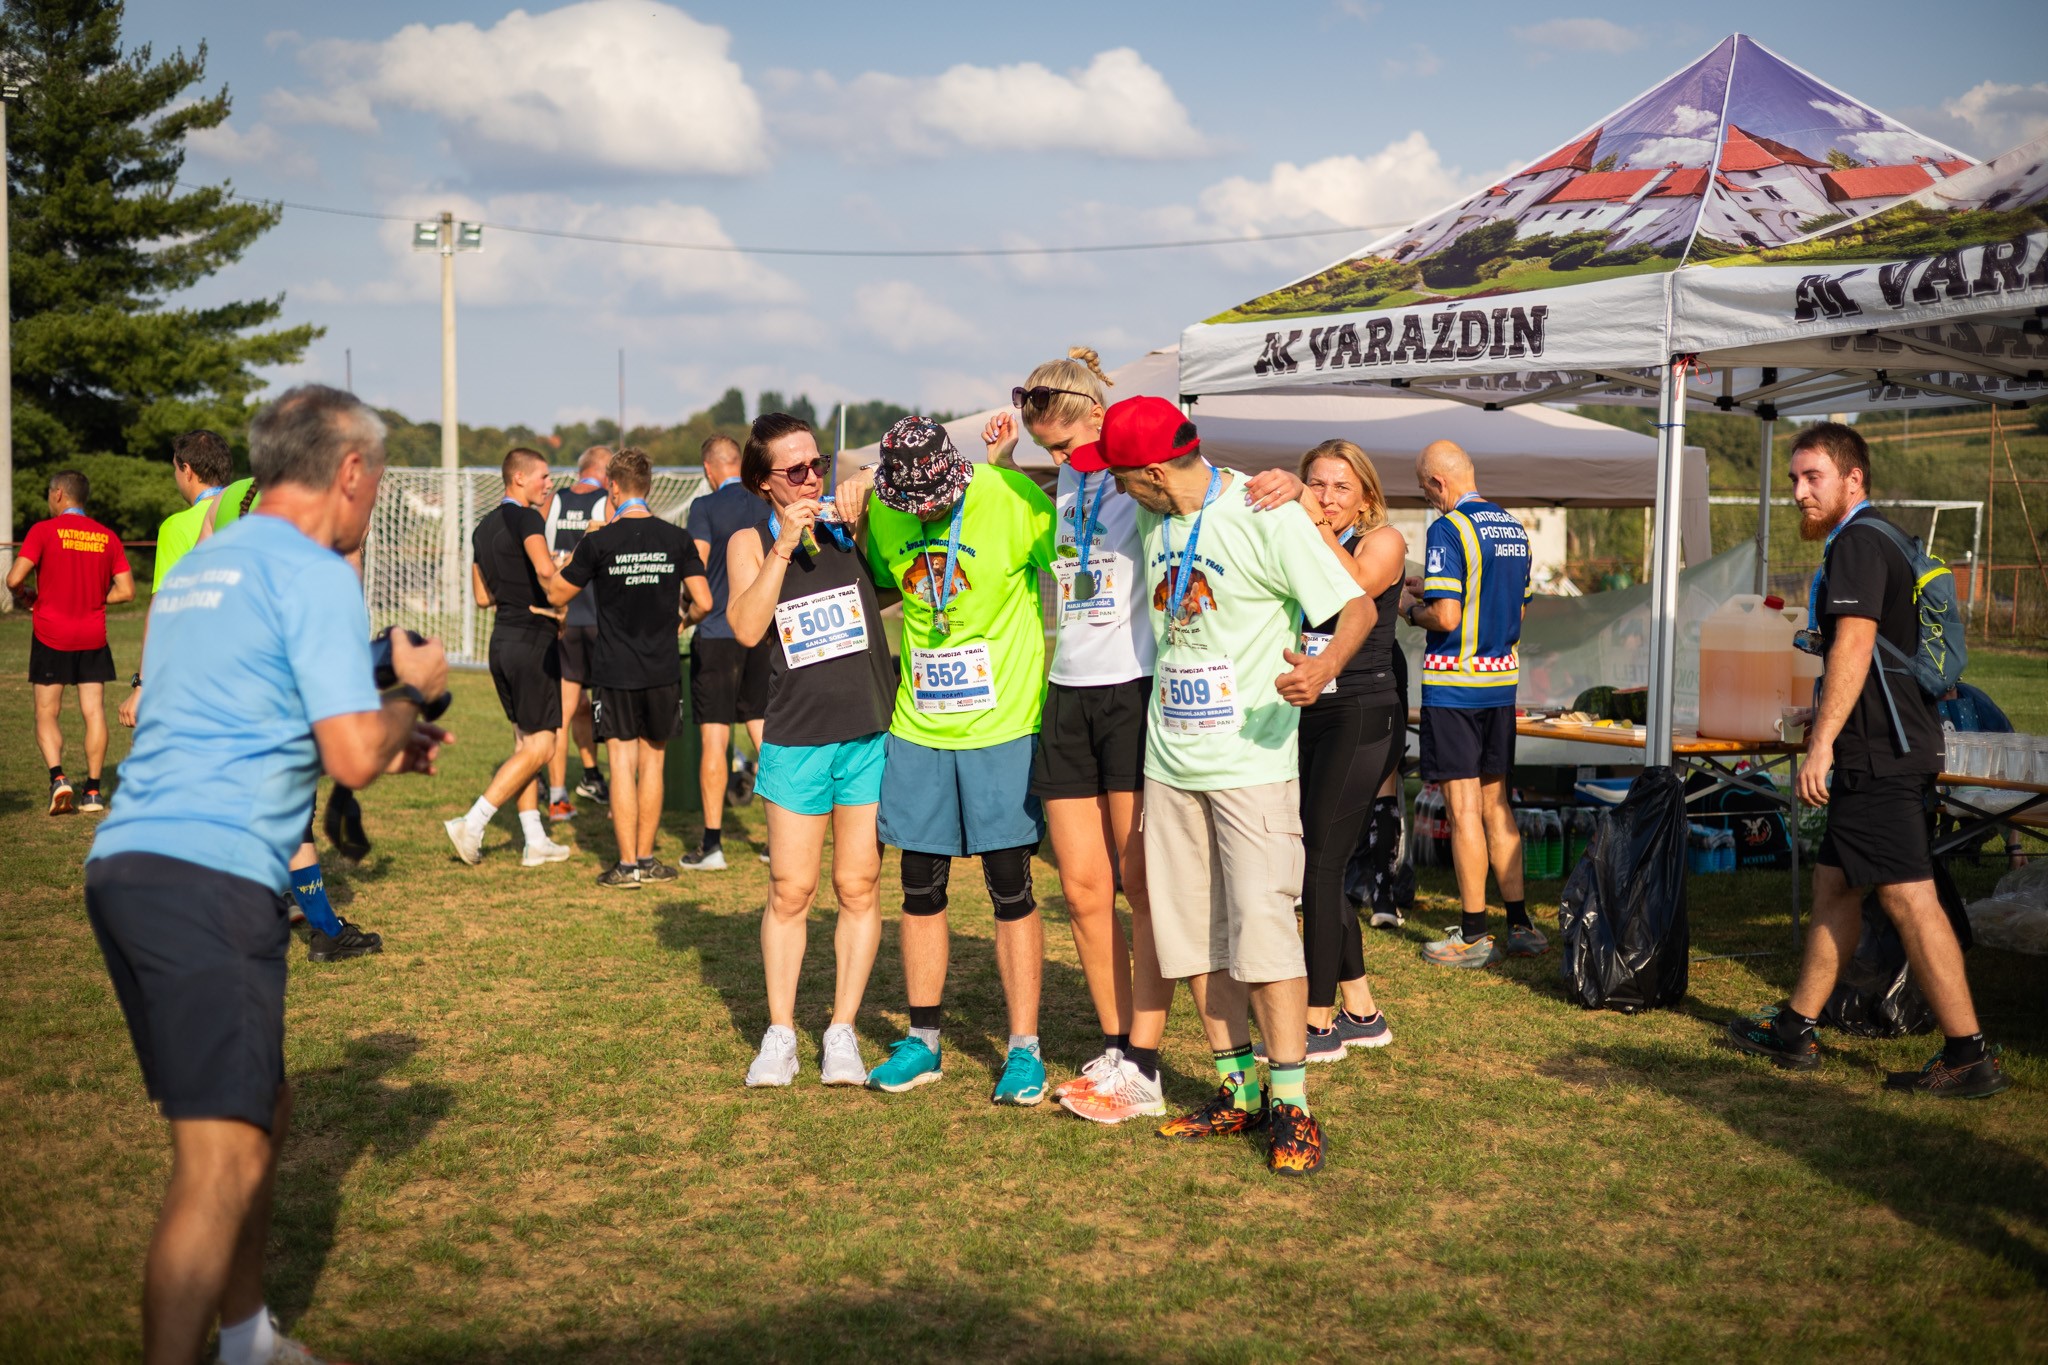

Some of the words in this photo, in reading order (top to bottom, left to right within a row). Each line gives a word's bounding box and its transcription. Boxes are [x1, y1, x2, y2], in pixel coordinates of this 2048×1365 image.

[1253, 329, 1303, 376] AK
[1309, 303, 1549, 371] VARAŽDIN
[57, 528, 109, 544] VATROGASCI
[62, 539, 105, 553] HREBINEC
[956, 543, 975, 558] TRAIL
[1205, 558, 1225, 576] TRAIL
[787, 601, 809, 611] ŠPILJA
[811, 594, 836, 604] VINDIJA
[838, 589, 856, 597] TRAIL
[798, 603, 845, 636] 500
[805, 638, 828, 648] SANJA
[829, 632, 849, 641] SOKOL
[926, 661, 969, 687] 552
[1170, 678, 1211, 705] 509
